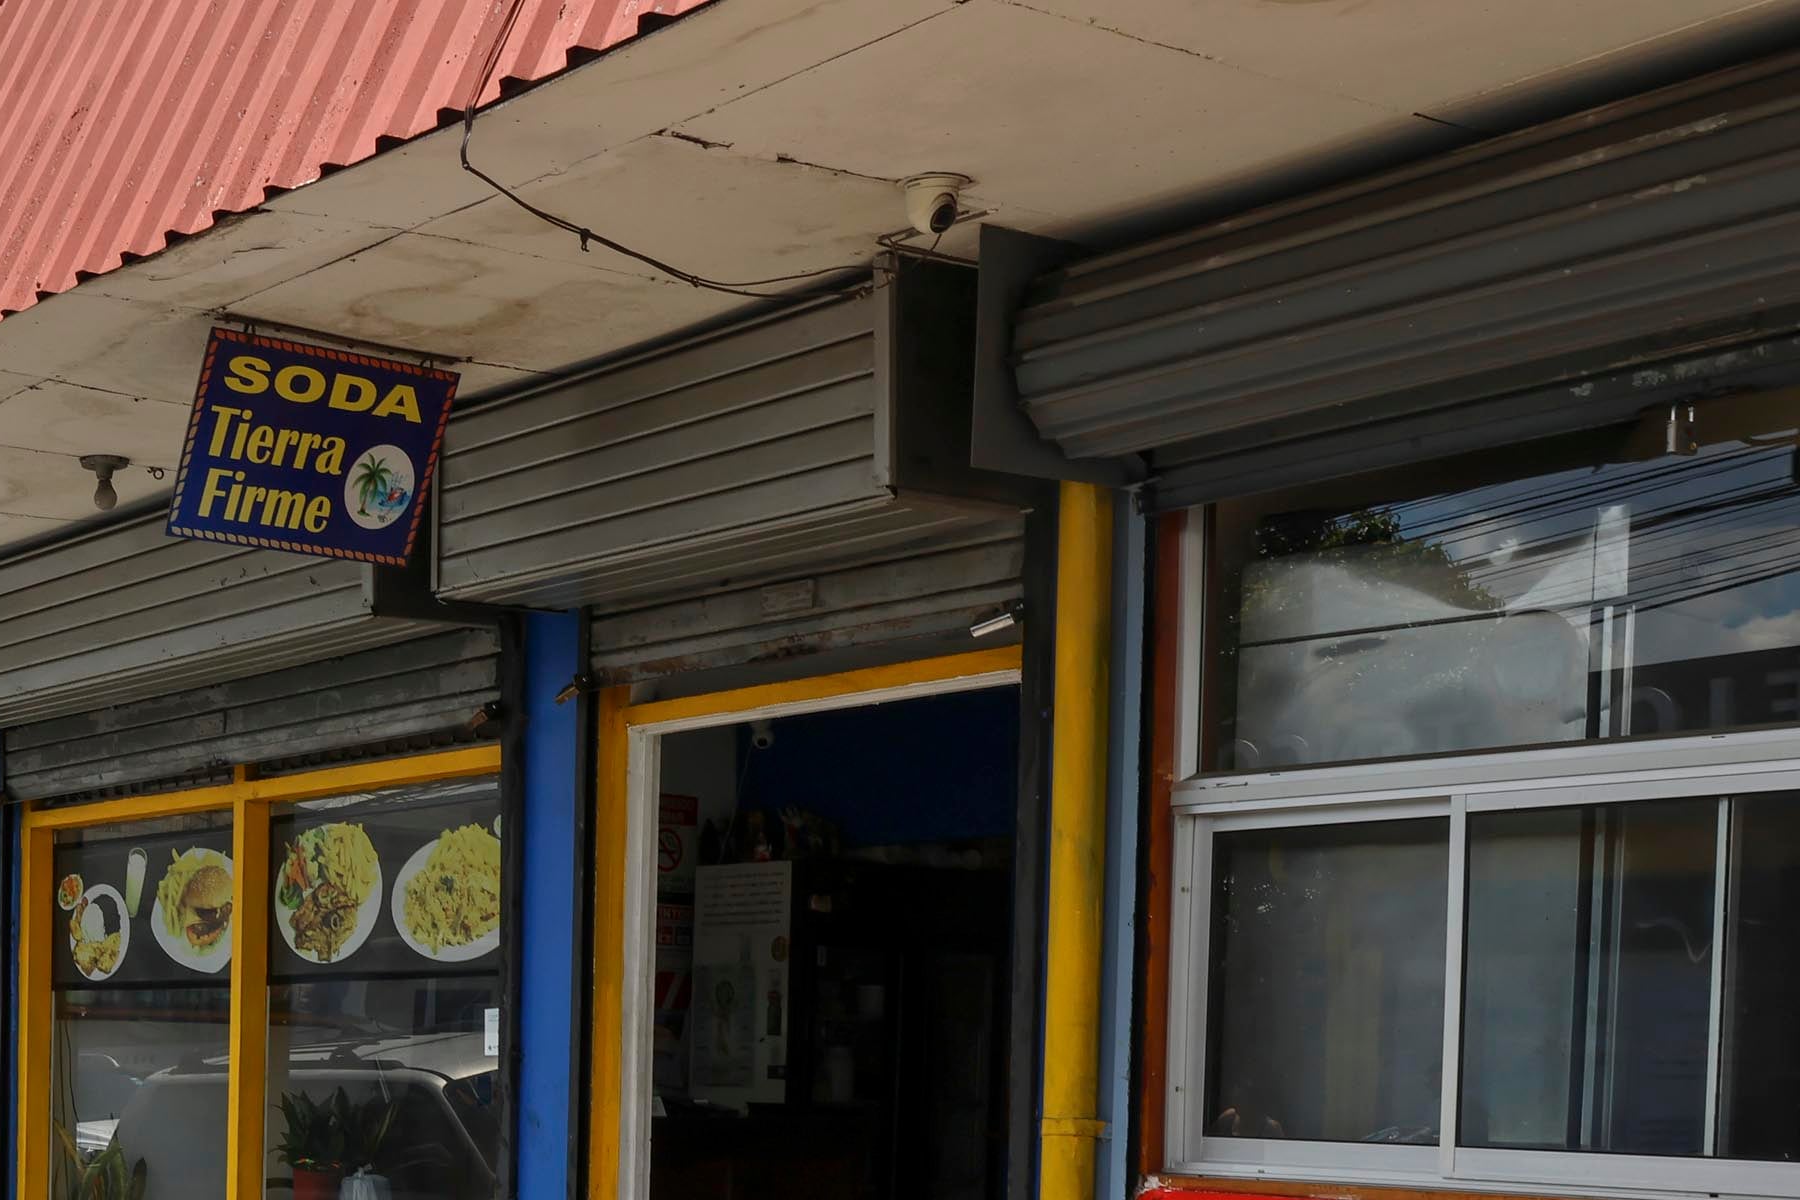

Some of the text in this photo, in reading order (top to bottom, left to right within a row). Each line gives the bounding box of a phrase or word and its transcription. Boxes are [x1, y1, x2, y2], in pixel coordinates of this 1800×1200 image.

[223, 355, 422, 424] SODA
[207, 404, 346, 475] Tierra
[197, 467, 333, 534] Firme
